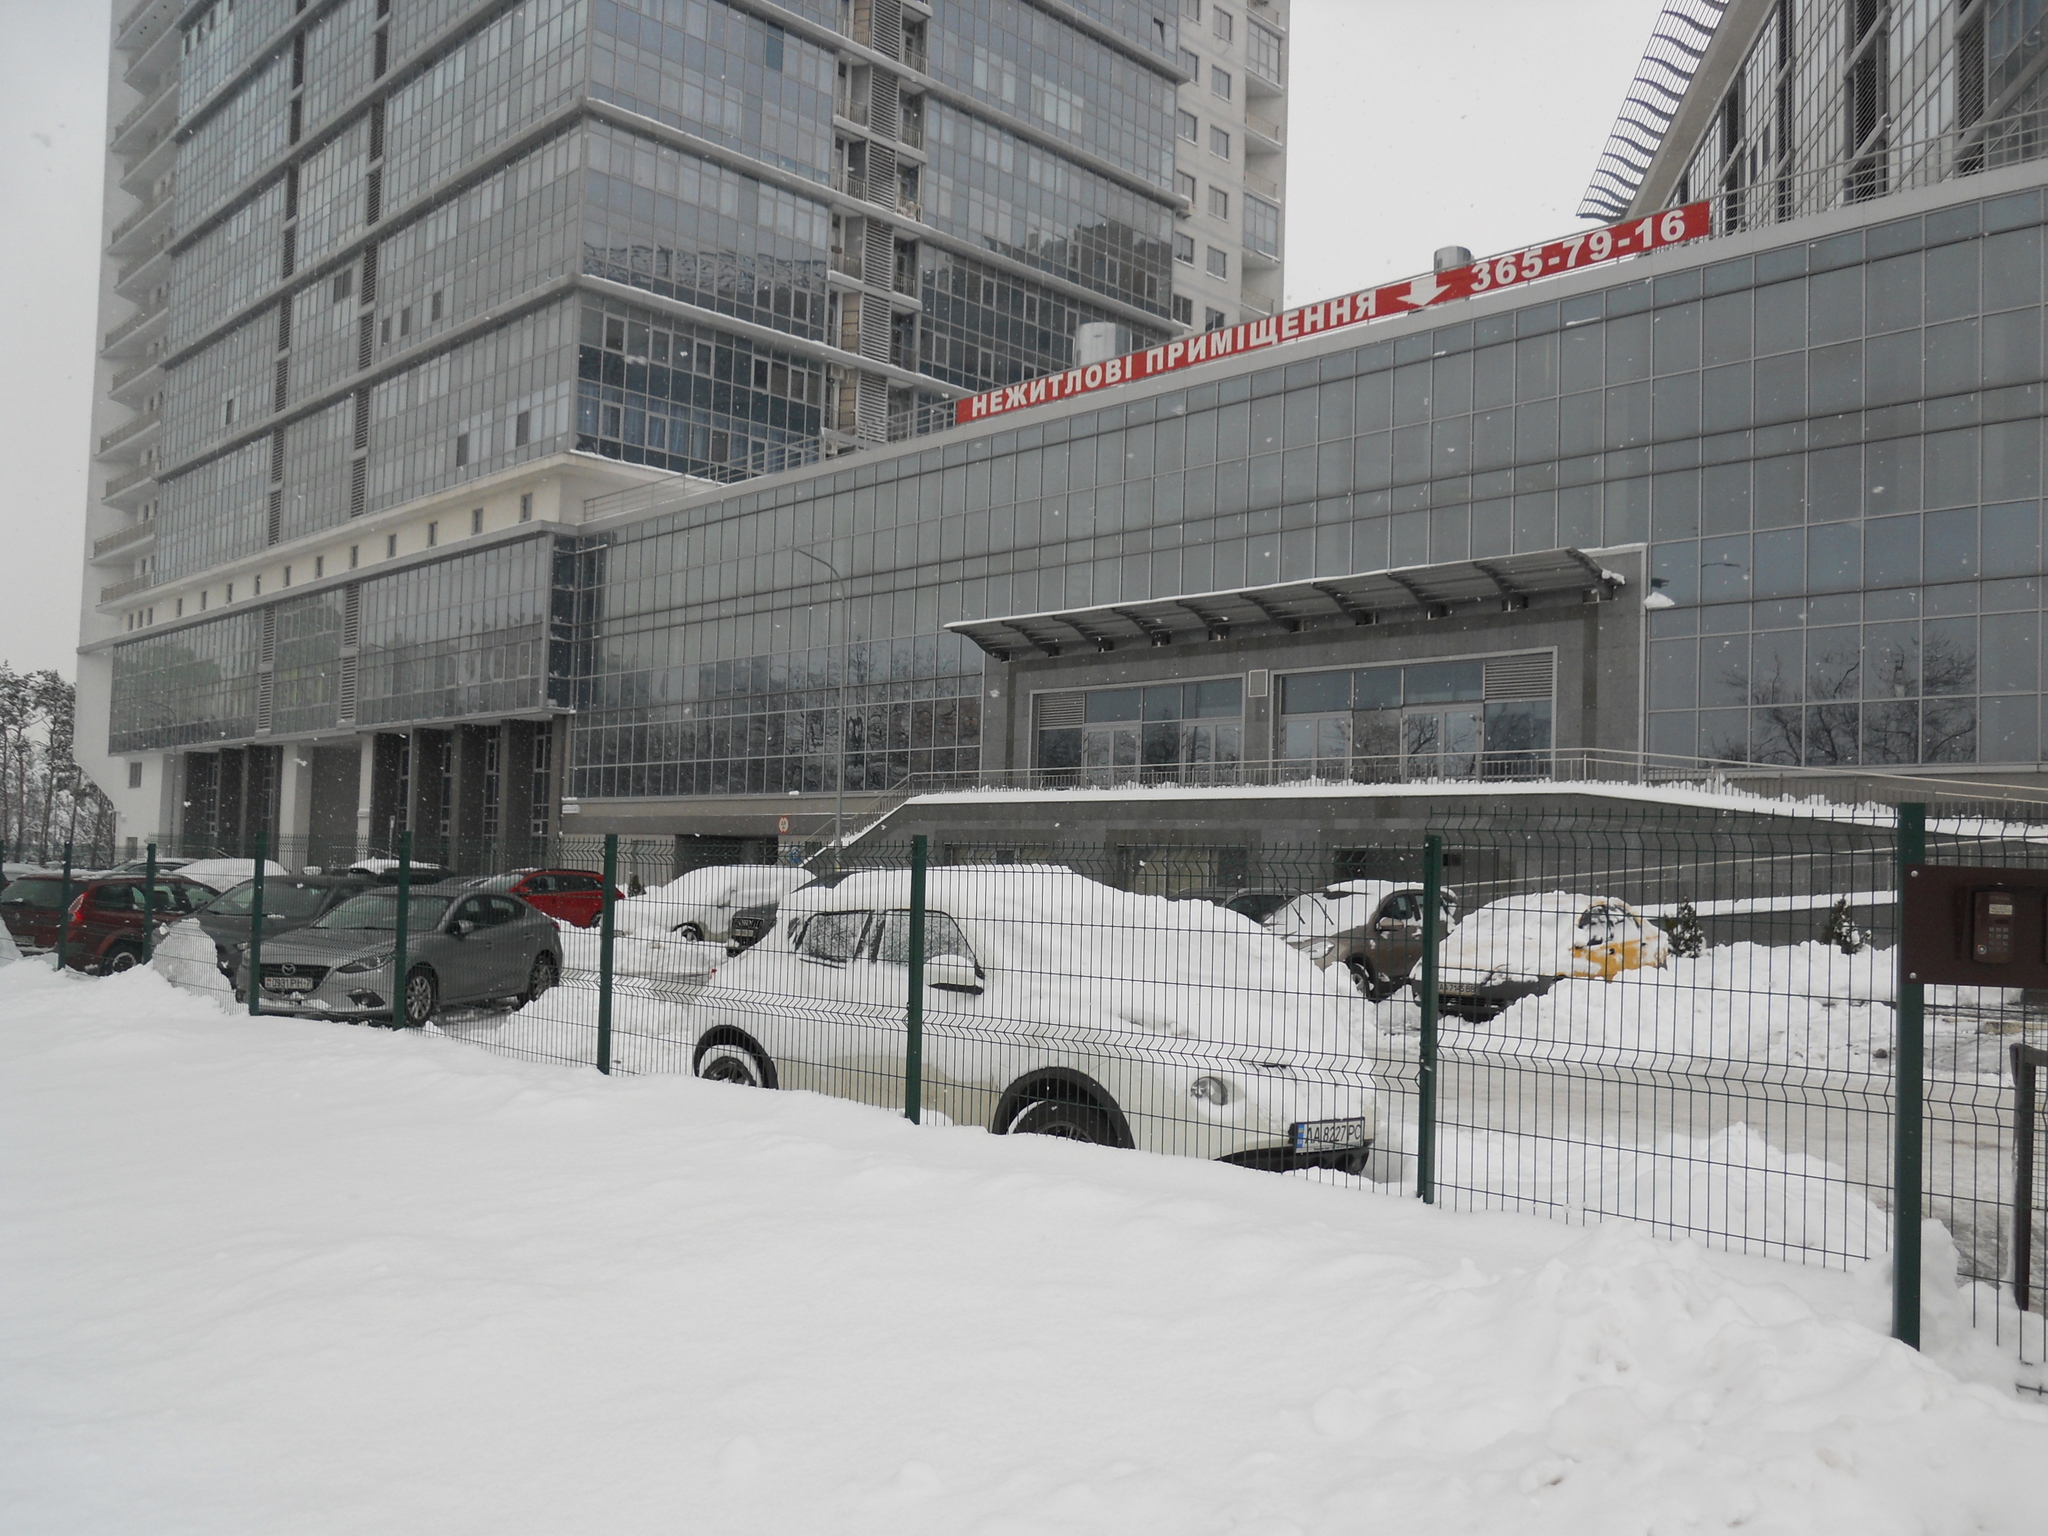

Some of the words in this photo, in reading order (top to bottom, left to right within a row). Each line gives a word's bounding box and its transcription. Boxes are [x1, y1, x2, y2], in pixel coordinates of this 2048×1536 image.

[971, 358, 1132, 418] НЕЖИТЛОВІ
[1146, 288, 1377, 373] ПРИМІЩЕННЯ
[1470, 209, 1686, 292] 365-79-16
[1305, 1126, 1320, 1144] AA
[1322, 1125, 1346, 1143] 8227
